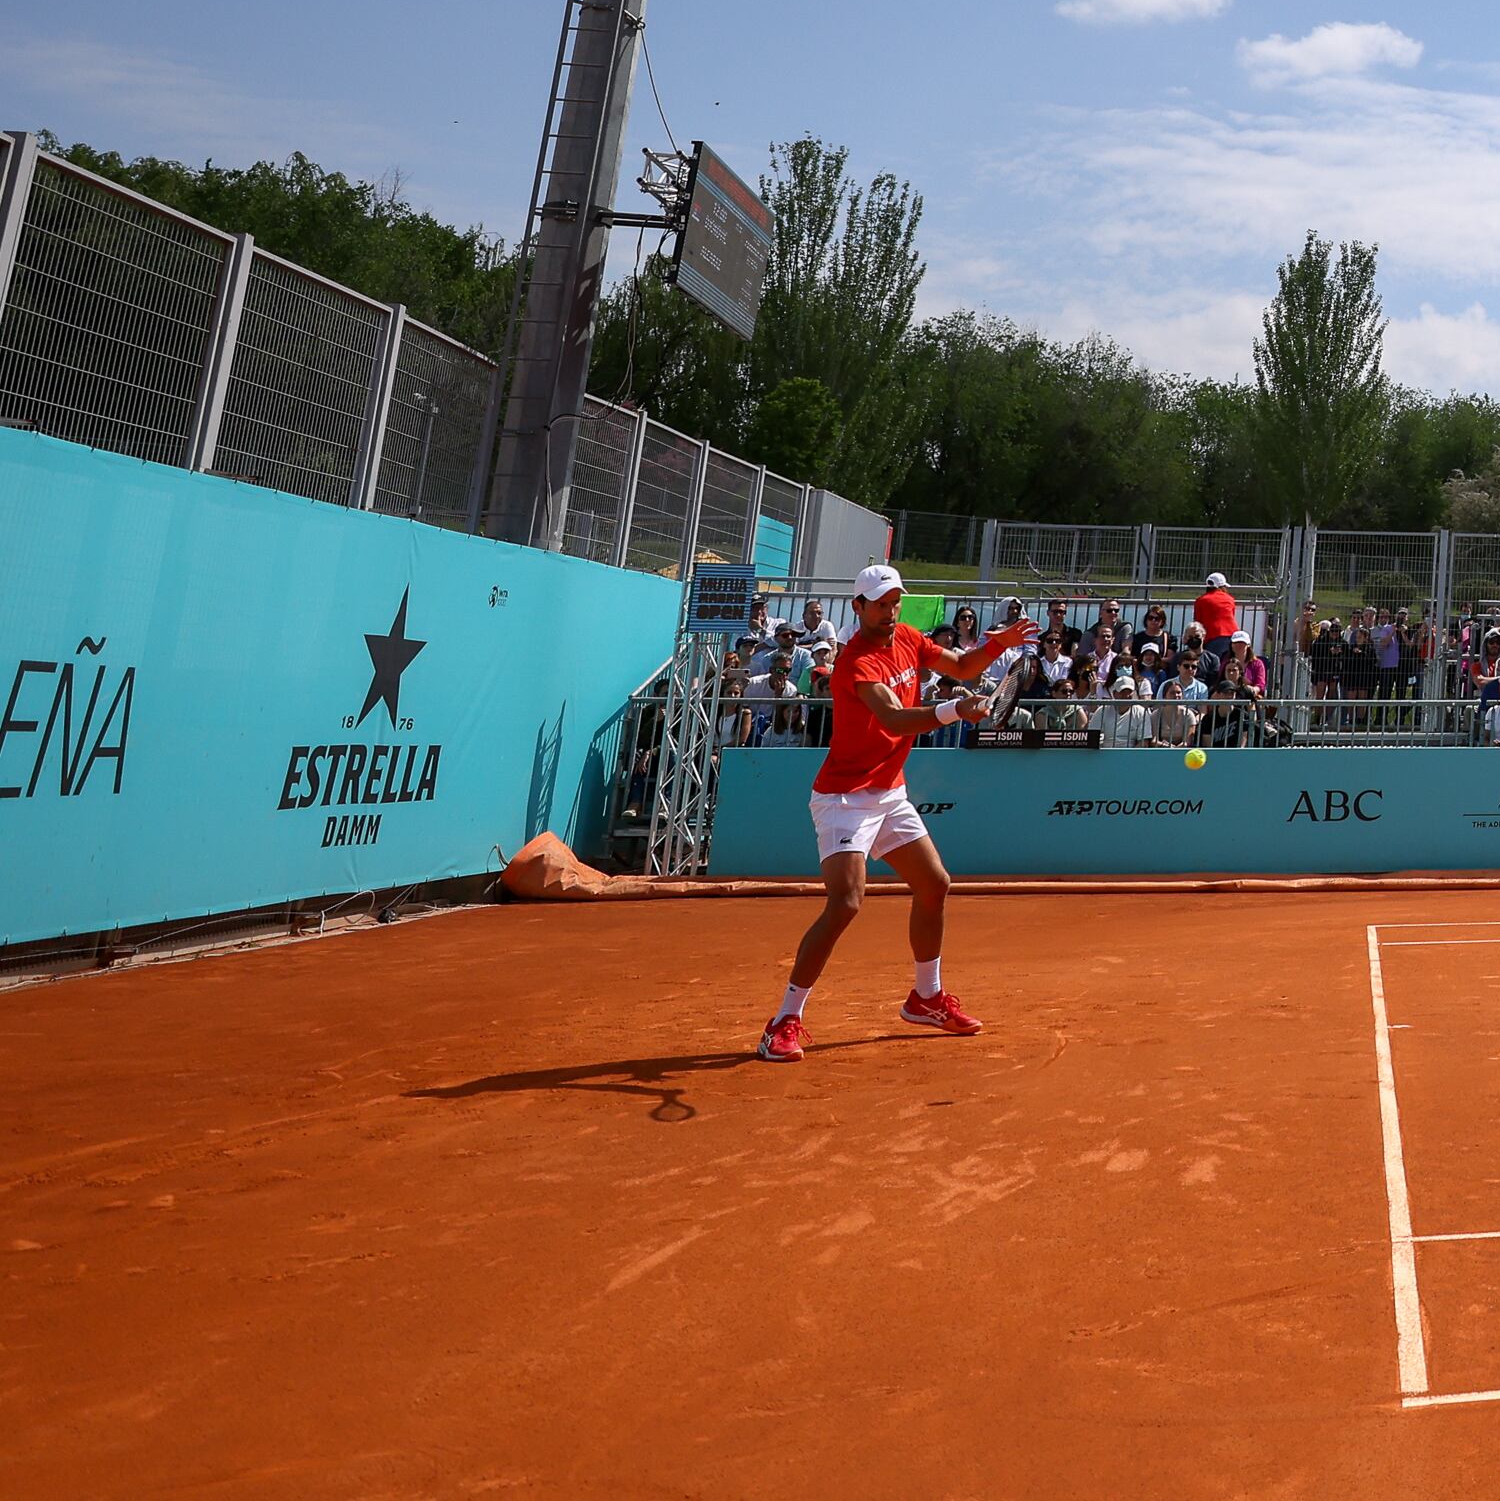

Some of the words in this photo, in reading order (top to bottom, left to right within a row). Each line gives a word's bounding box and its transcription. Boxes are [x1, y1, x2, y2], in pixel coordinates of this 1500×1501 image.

[701, 578, 747, 591] MUTUA
[0, 637, 136, 798] EÑA
[341, 716, 354, 728] 18
[399, 718, 414, 730] 76
[998, 732, 1023, 740] ISDIN
[1063, 732, 1088, 740] ISDIN
[277, 745, 442, 810] ESTRELLA
[1286, 789, 1384, 822] ABC
[321, 814, 382, 848] DAMM
